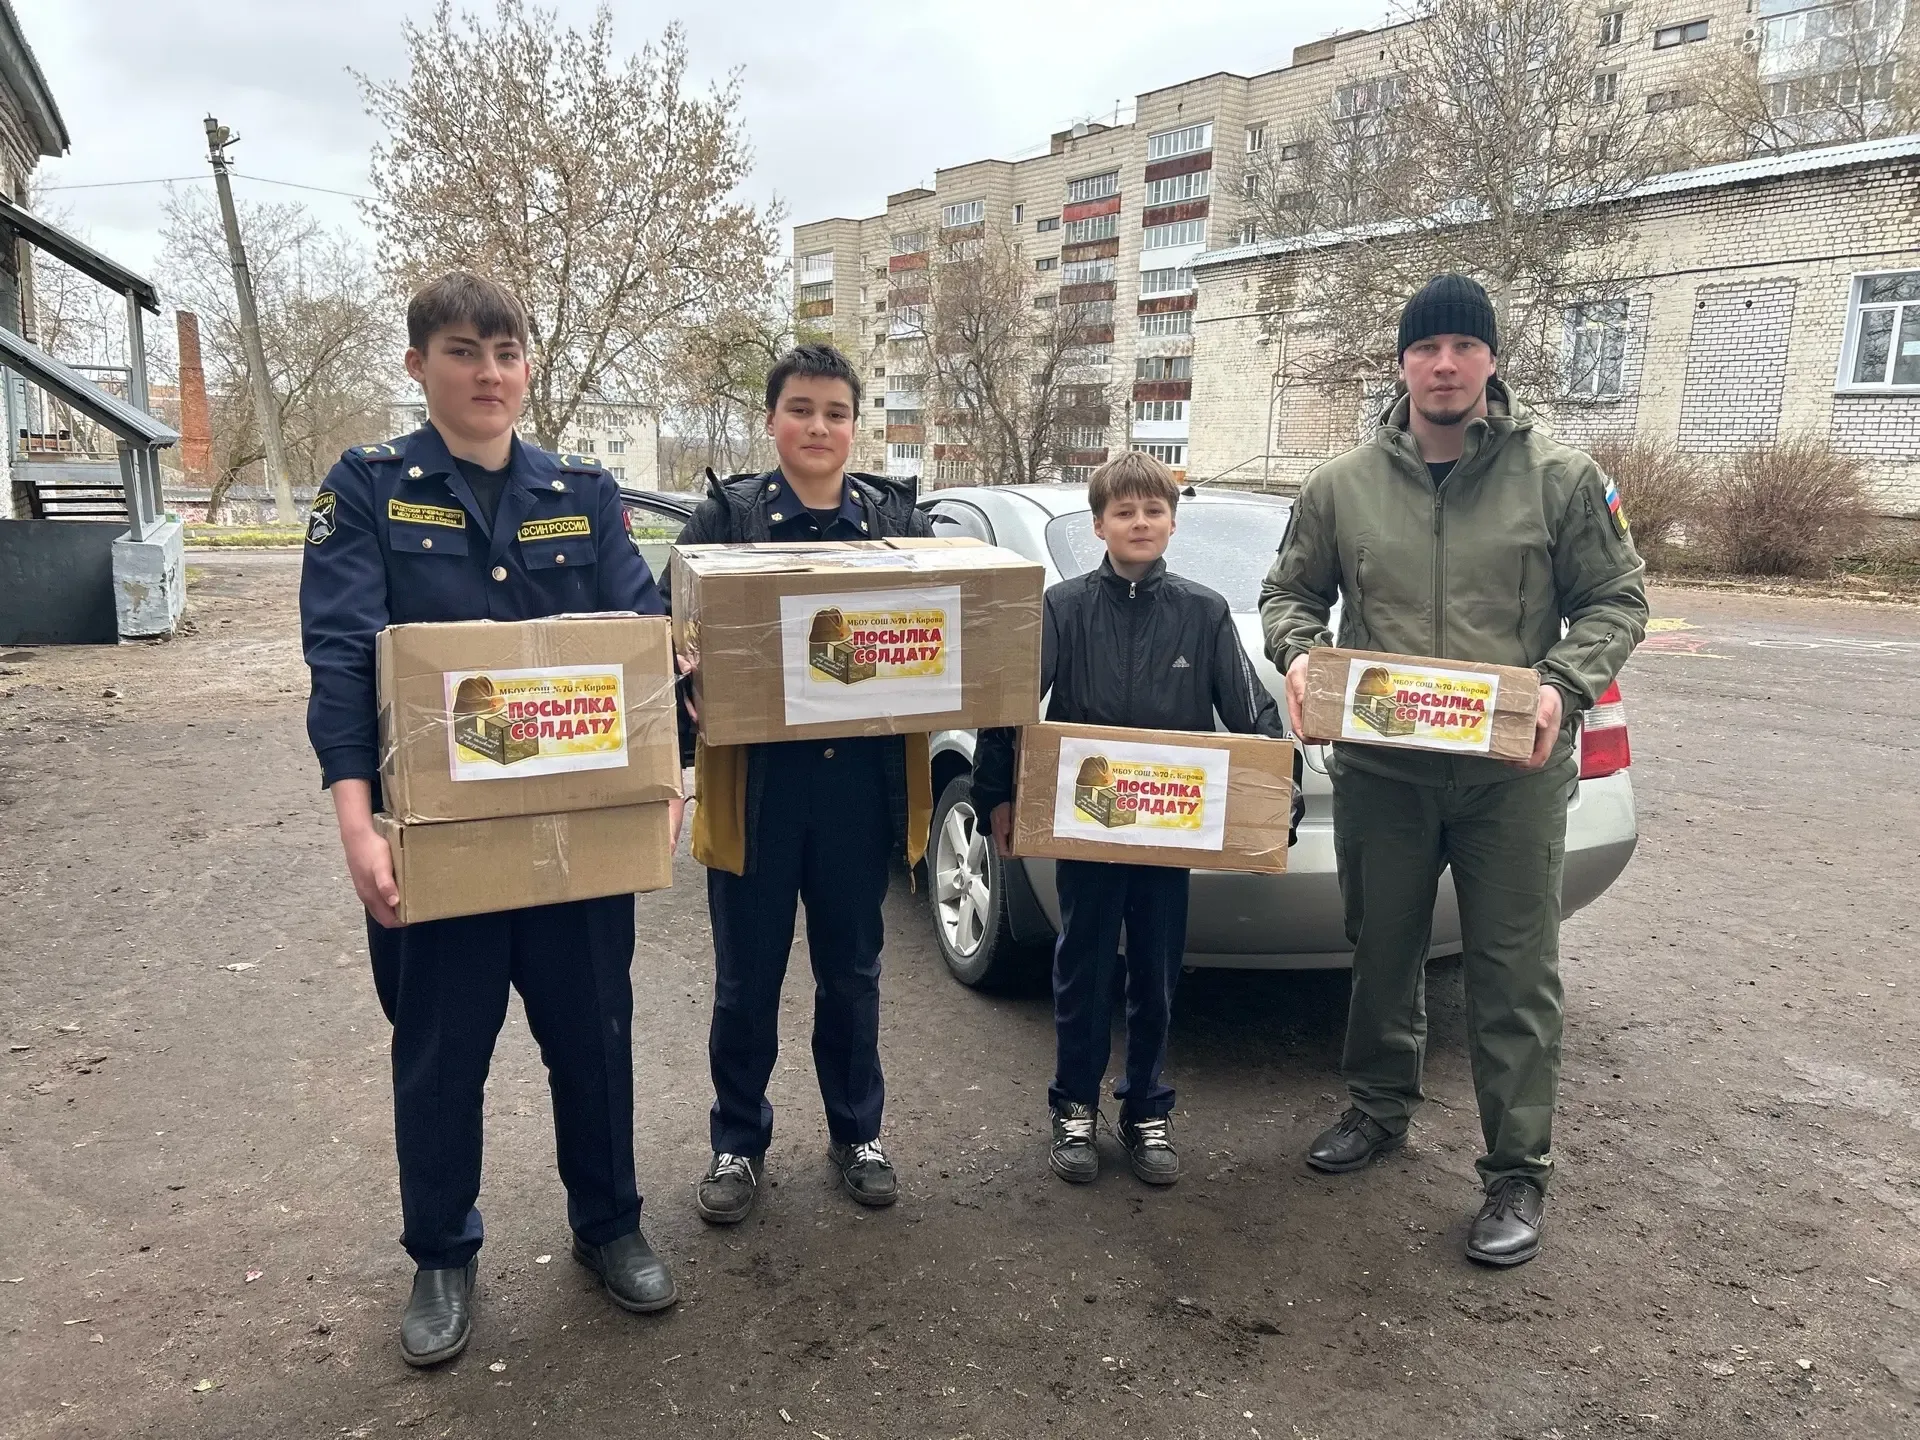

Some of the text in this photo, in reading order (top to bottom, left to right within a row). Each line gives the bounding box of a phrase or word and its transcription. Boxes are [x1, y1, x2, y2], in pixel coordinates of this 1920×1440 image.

[521, 520, 586, 536] ФСИН РОССИИ
[870, 618, 888, 626] СОШ
[889, 617, 907, 625] №70
[916, 616, 943, 626] Кирова
[853, 628, 942, 645] ПОСЫЛКА
[854, 646, 940, 665] СОЛДАТУ
[499, 687, 526, 696] МБОУ
[528, 685, 550, 695] СОШ
[553, 684, 573, 693] №70
[584, 683, 616, 694] Кирова
[1393, 678, 1413, 687] МБОУ
[1415, 681, 1433, 689] СОШ
[1435, 683, 1452, 691] №70
[1460, 685, 1489, 696] Кирова
[508, 697, 617, 719] ПОСЫЛКА
[1395, 690, 1486, 712] ПОСЫЛКА
[1395, 707, 1483, 729] СОЛДАТУ
[511, 718, 616, 741] СОЛДАТУ
[1111, 767, 1132, 776] МБОУ
[1133, 769, 1150, 777] СОШ
[1177, 772, 1204, 781] Кирова
[1116, 779, 1202, 798] ПОСЫЛКА
[1116, 797, 1199, 816] СОЛДАТУ
